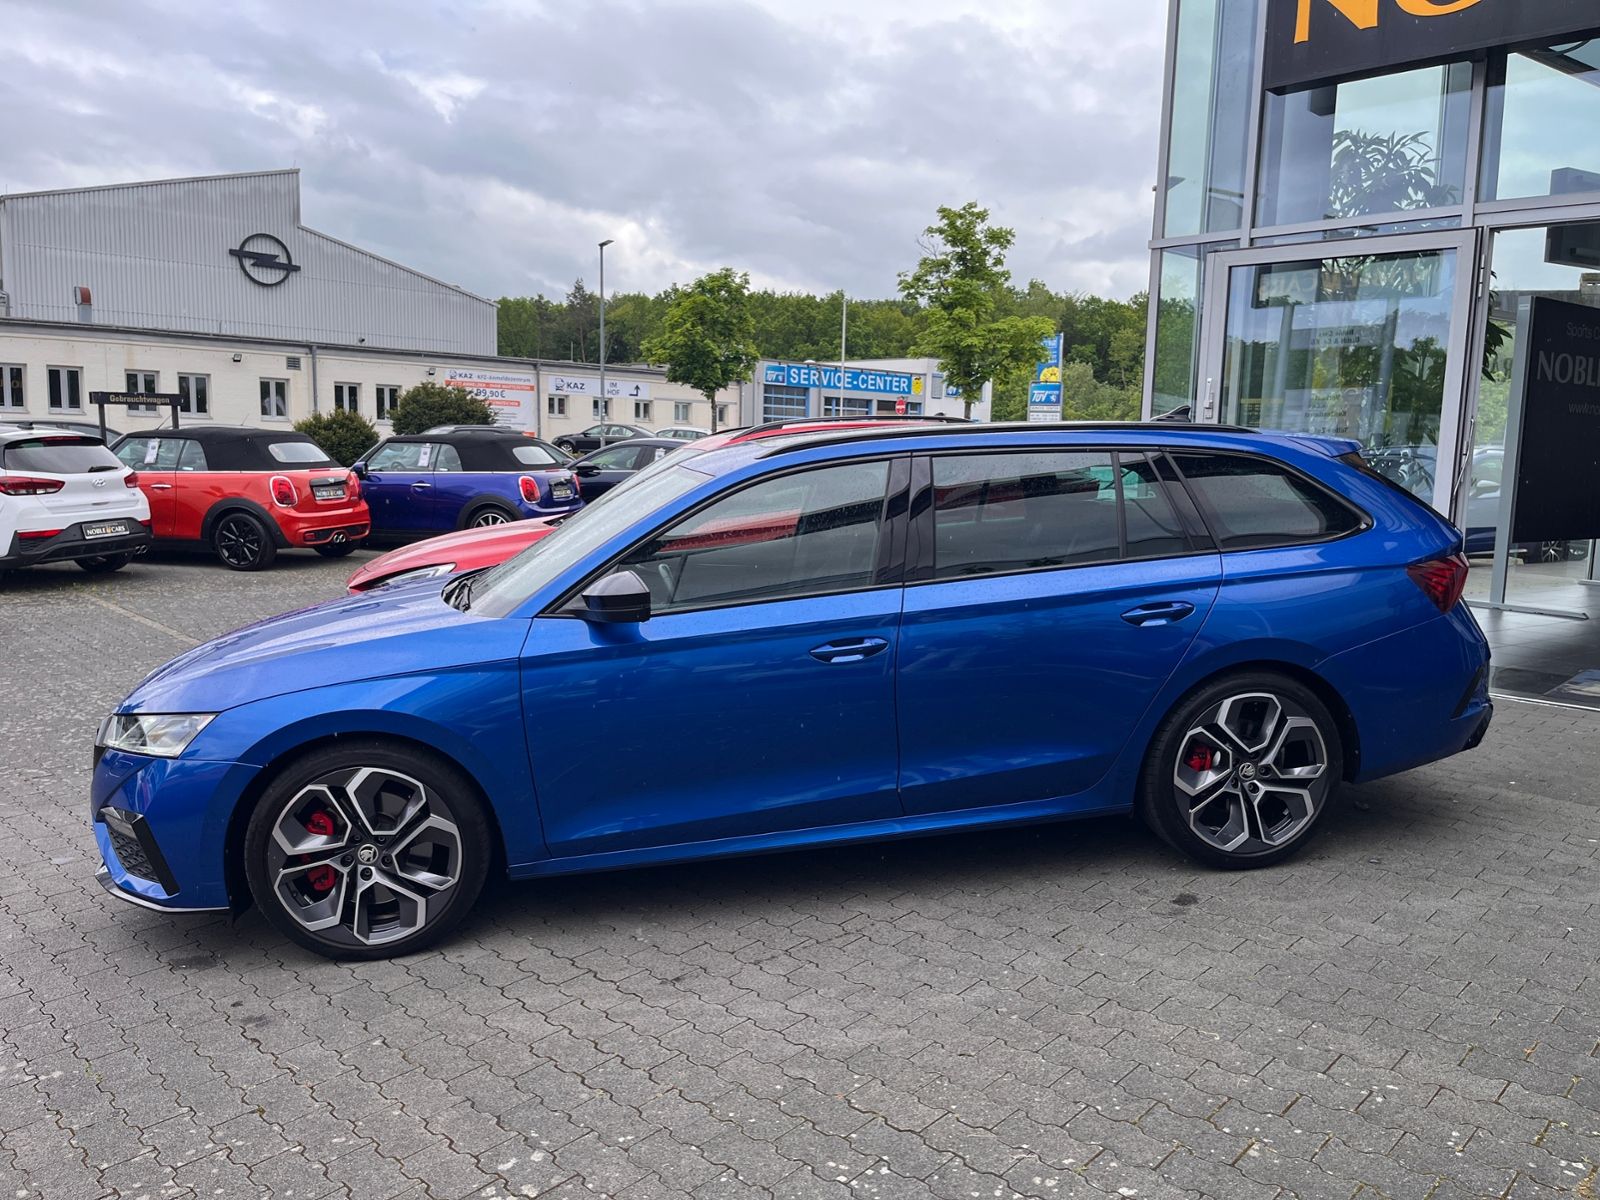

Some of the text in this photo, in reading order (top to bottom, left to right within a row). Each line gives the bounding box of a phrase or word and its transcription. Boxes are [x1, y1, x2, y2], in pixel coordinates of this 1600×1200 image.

[1536, 350, 1600, 388] NOBL
[790, 368, 909, 392] SERVICE-CENTER
[566, 382, 585, 390] KAZ
[109, 394, 170, 405] Gebrauchtwagen
[86, 525, 126, 536] NOBLE CARS
